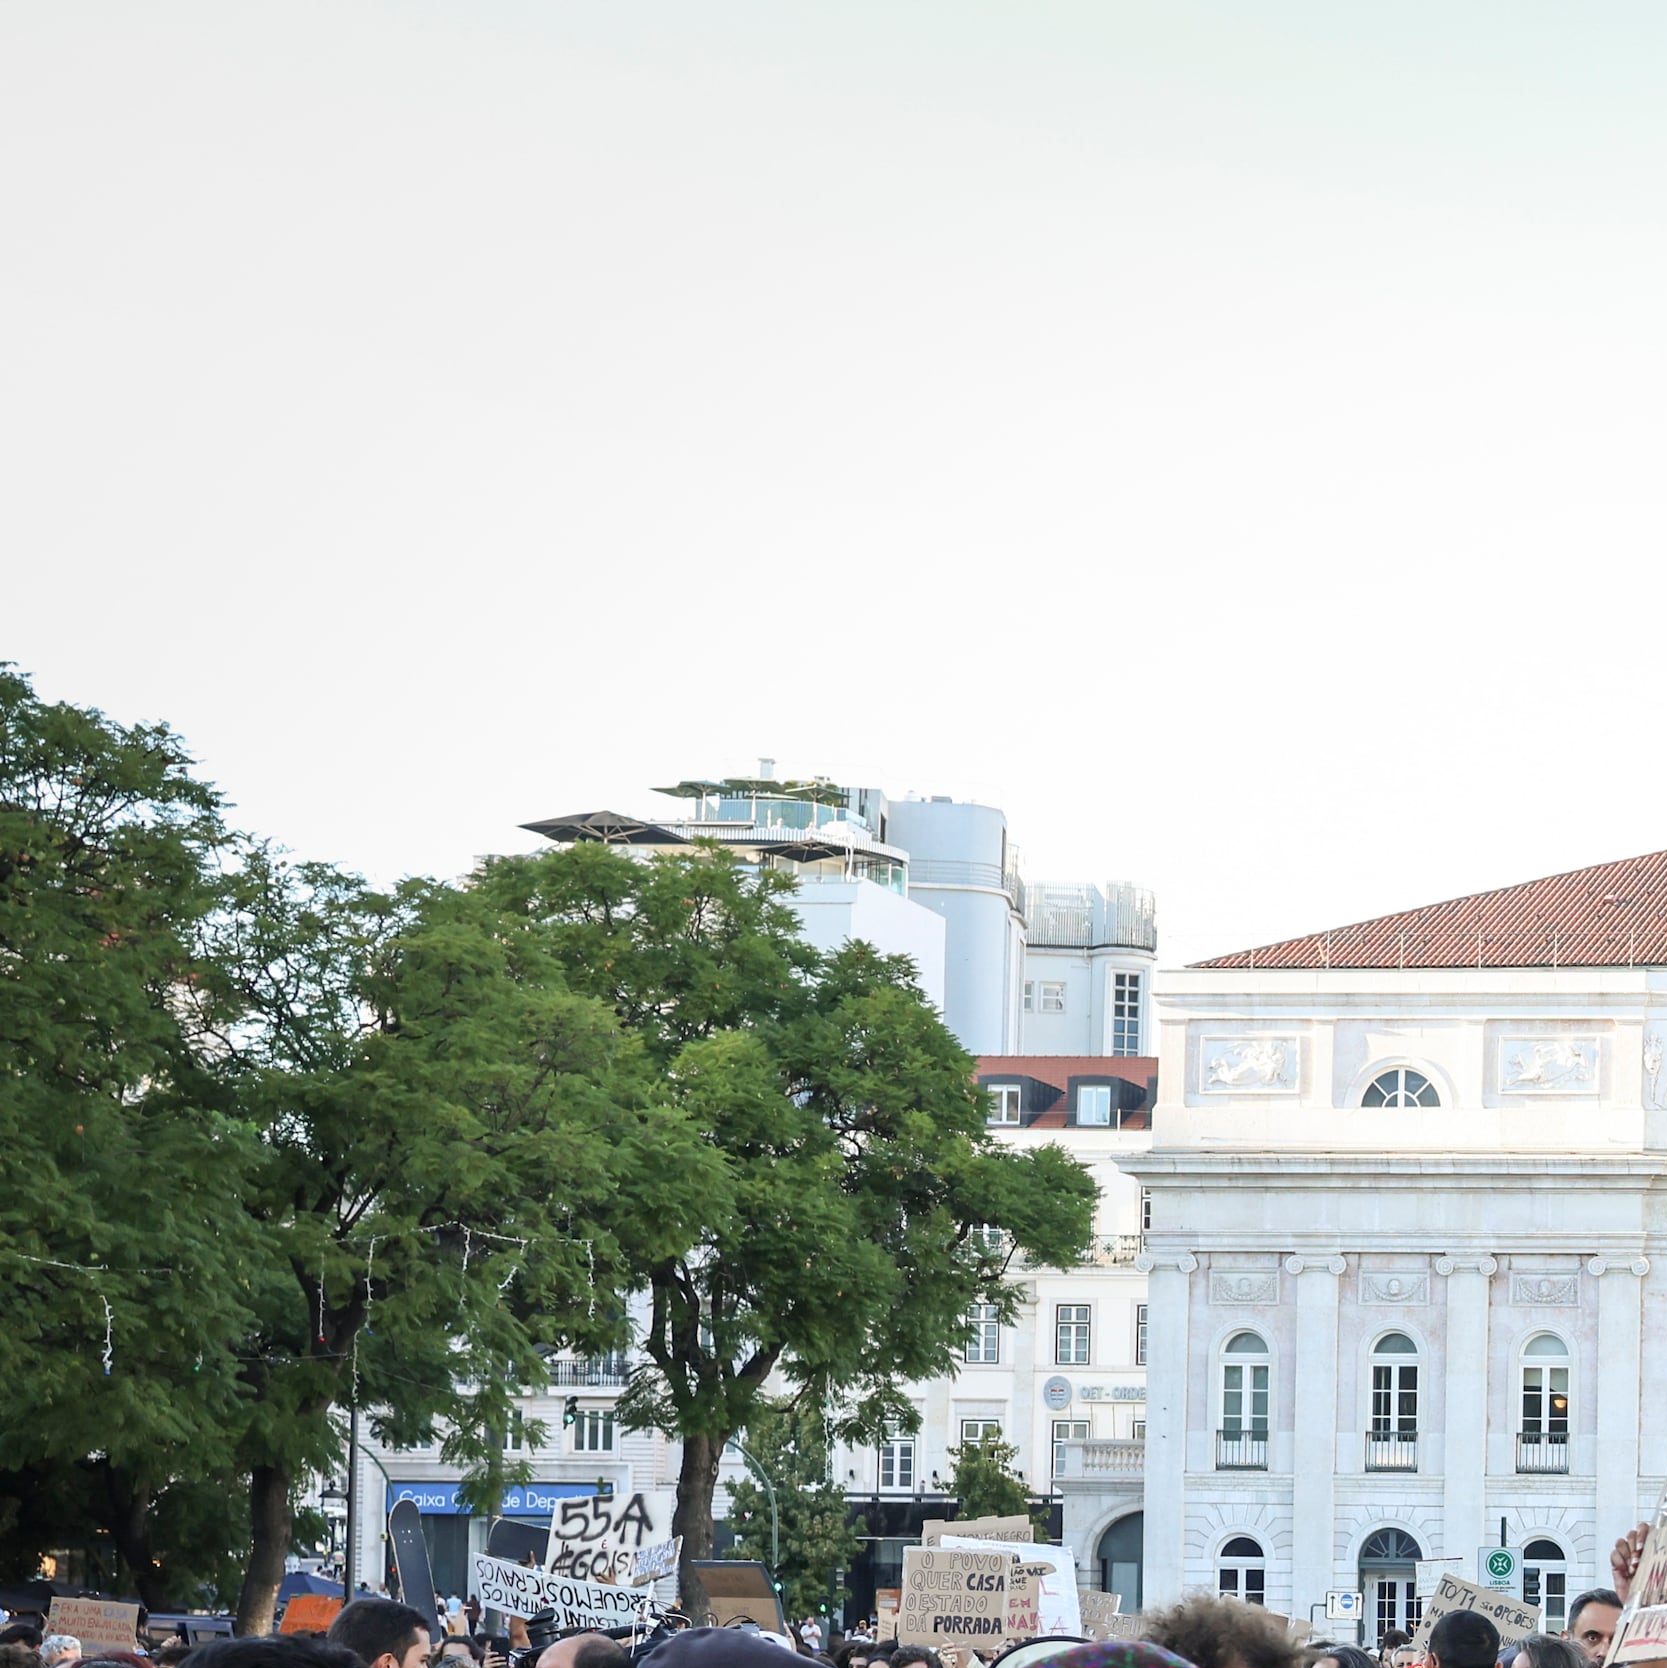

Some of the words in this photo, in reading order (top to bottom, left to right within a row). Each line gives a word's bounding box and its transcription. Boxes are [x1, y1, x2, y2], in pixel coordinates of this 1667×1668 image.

[921, 1550, 934, 1569] O
[950, 1552, 1002, 1572] POVO
[476, 1559, 541, 1596] CRAVOS
[909, 1570, 963, 1592] QUER
[966, 1572, 1005, 1592] CASA
[933, 1616, 1002, 1634] PORRADA
[1494, 1604, 1536, 1630] OPÇÕES
